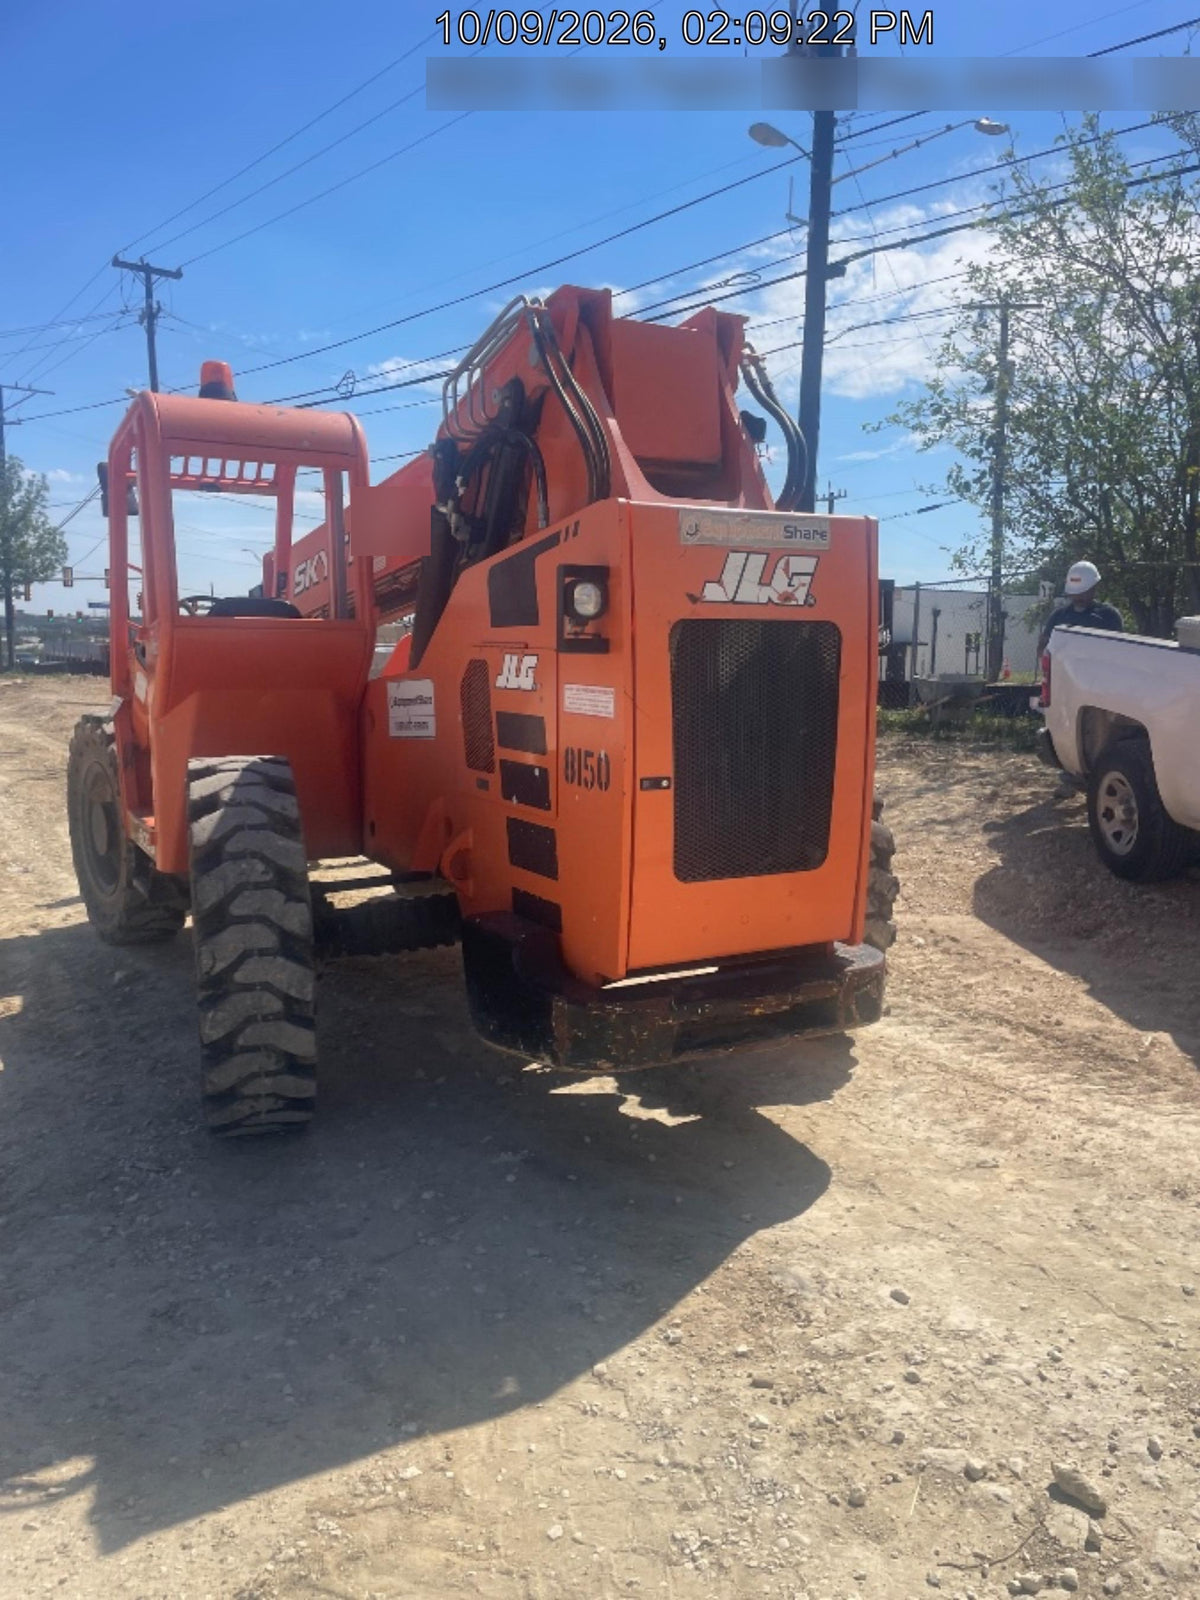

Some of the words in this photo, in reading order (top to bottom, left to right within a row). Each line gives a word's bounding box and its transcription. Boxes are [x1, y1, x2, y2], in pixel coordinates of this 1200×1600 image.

[701, 551, 820, 606] JLG
[495, 653, 539, 691] JLG
[564, 746, 612, 792] 8150
